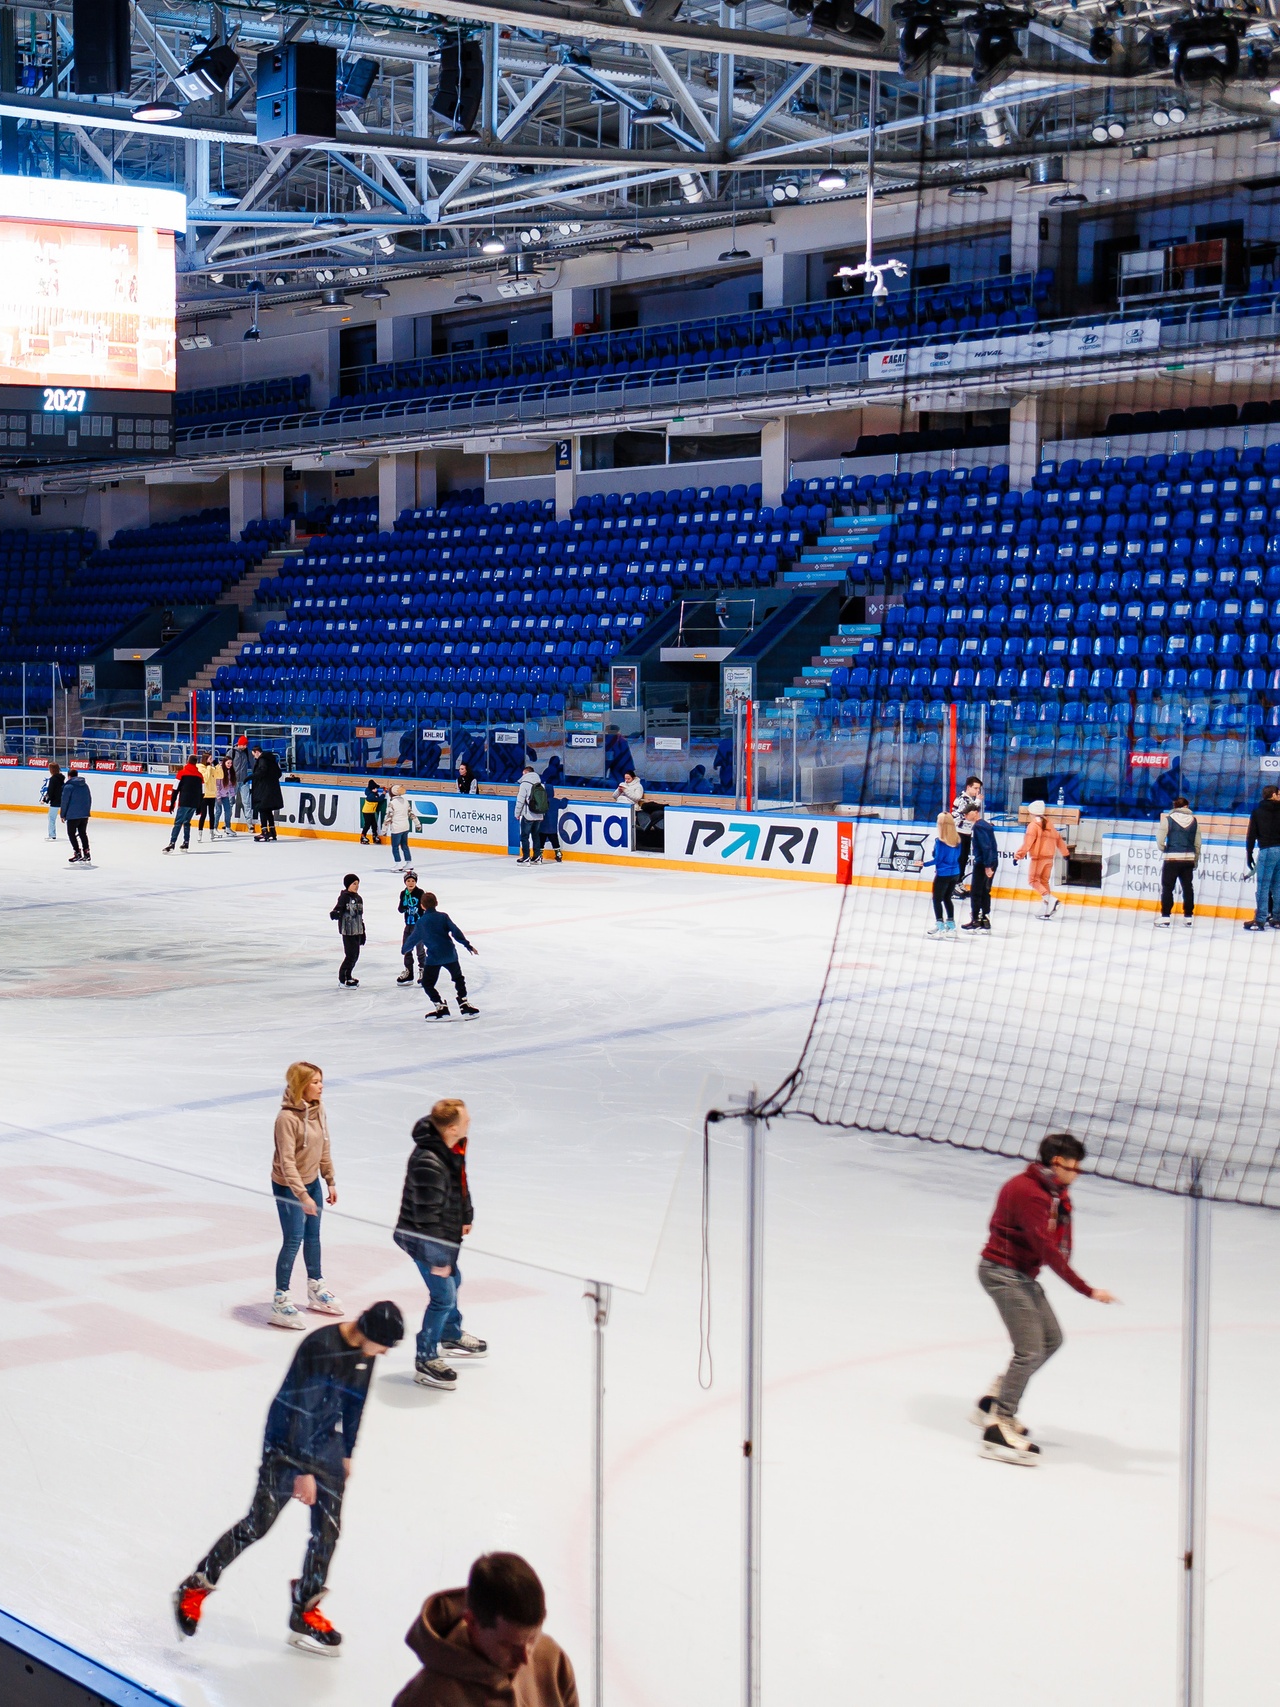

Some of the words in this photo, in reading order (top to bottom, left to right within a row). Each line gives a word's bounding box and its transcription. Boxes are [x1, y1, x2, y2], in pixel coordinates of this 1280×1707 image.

[974, 349, 1004, 358] HAVAL
[43, 388, 87, 412] 20:27
[560, 443, 568, 458] 2
[424, 731, 444, 739] KHL.RU
[28, 758, 48, 767] FONBET
[1130, 754, 1169, 765] FONBET
[70, 761, 89, 769] FONBET
[96, 762, 115, 771] FONBET
[122, 764, 142, 773] FONBET
[112, 780, 179, 813] FONB
[449, 808, 502, 823] Платёжная
[449, 823, 488, 835] система
